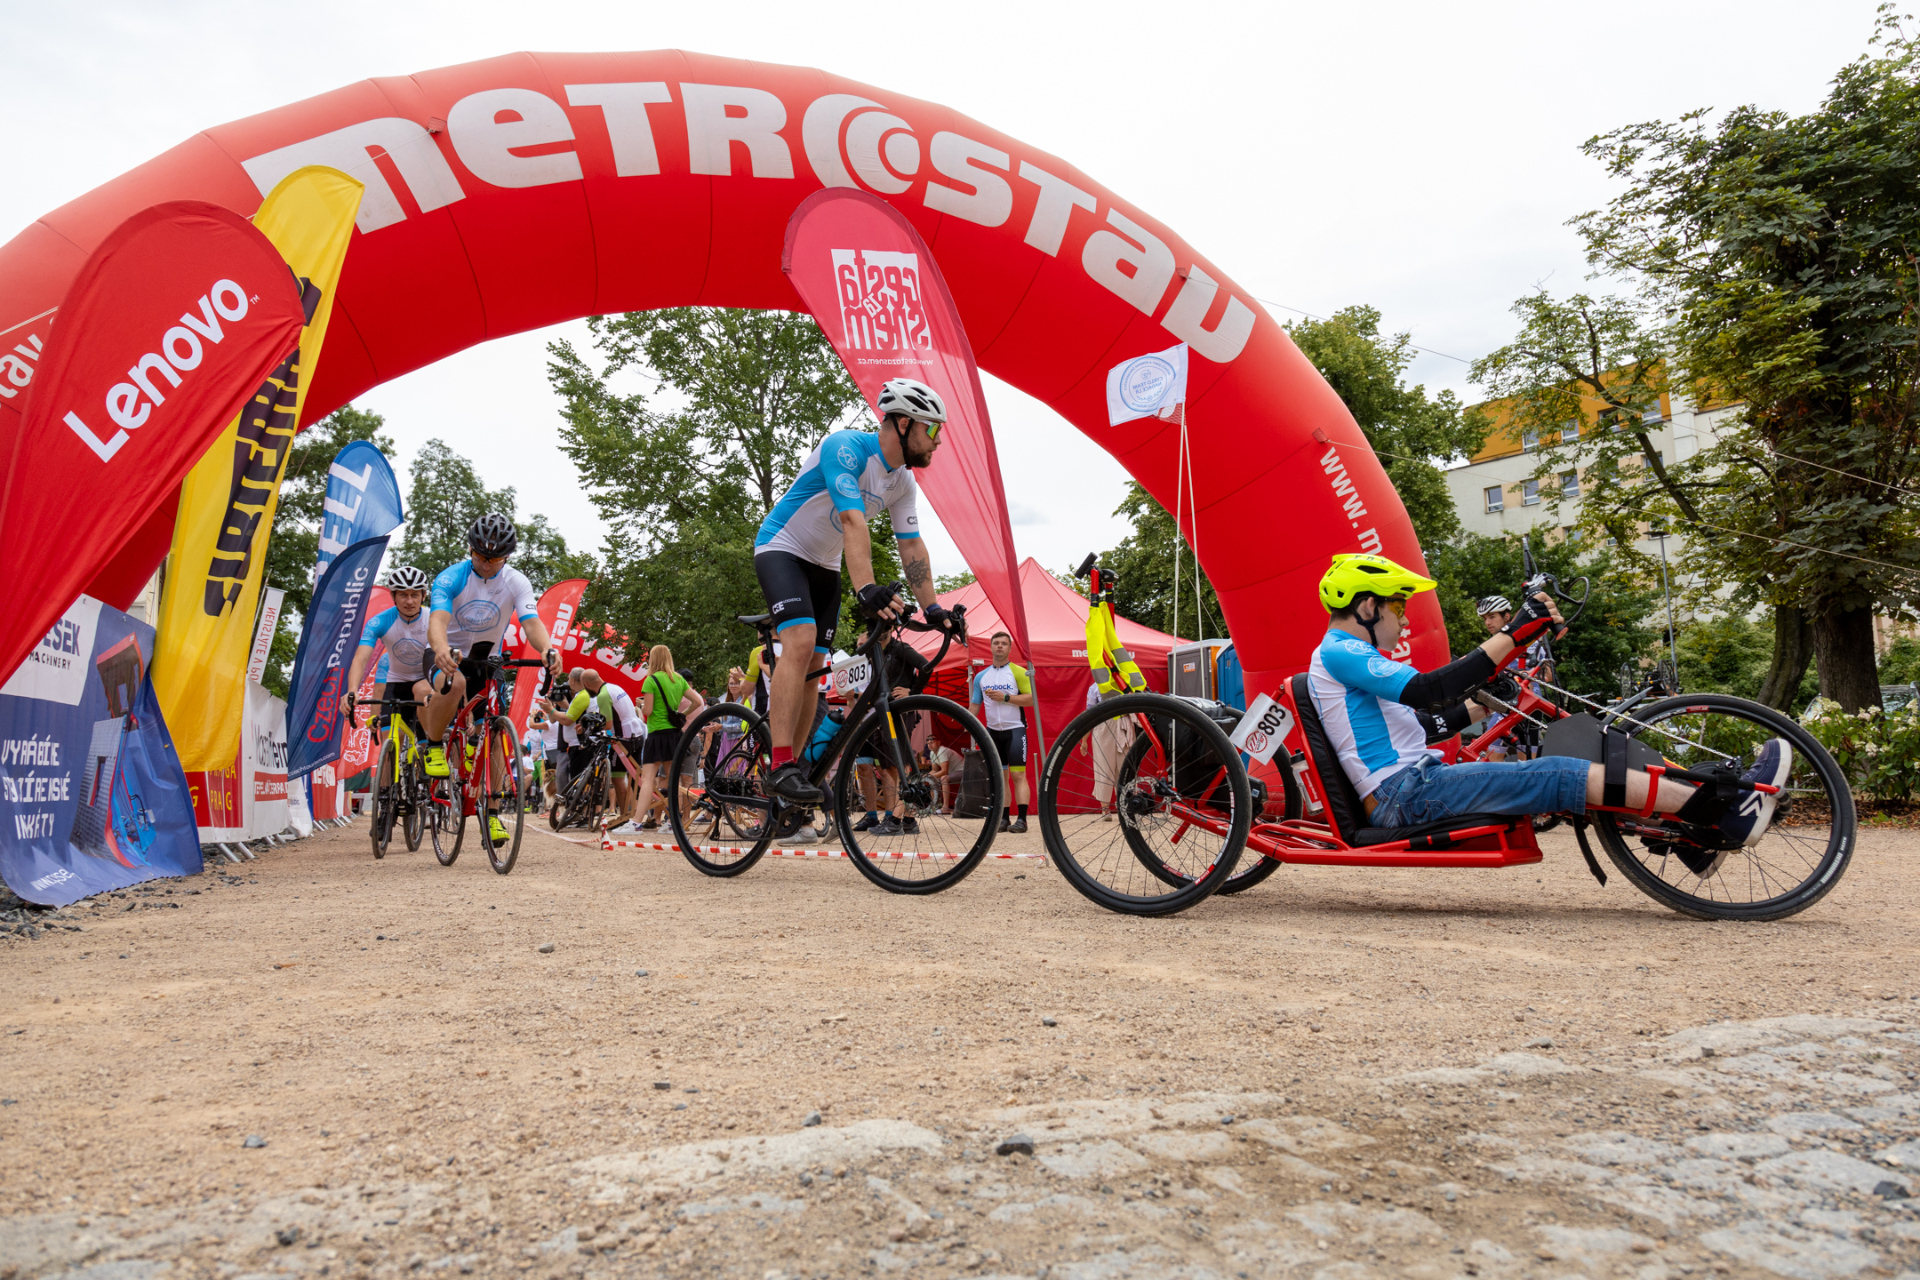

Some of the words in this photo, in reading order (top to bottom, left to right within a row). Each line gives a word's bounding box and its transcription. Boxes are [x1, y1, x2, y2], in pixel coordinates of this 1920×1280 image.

[63, 279, 249, 463] Lenovo
[1354, 555, 1387, 565] FOX
[29, 650, 71, 670] MACHINERY
[848, 664, 866, 684] 803
[1257, 704, 1286, 736] 803
